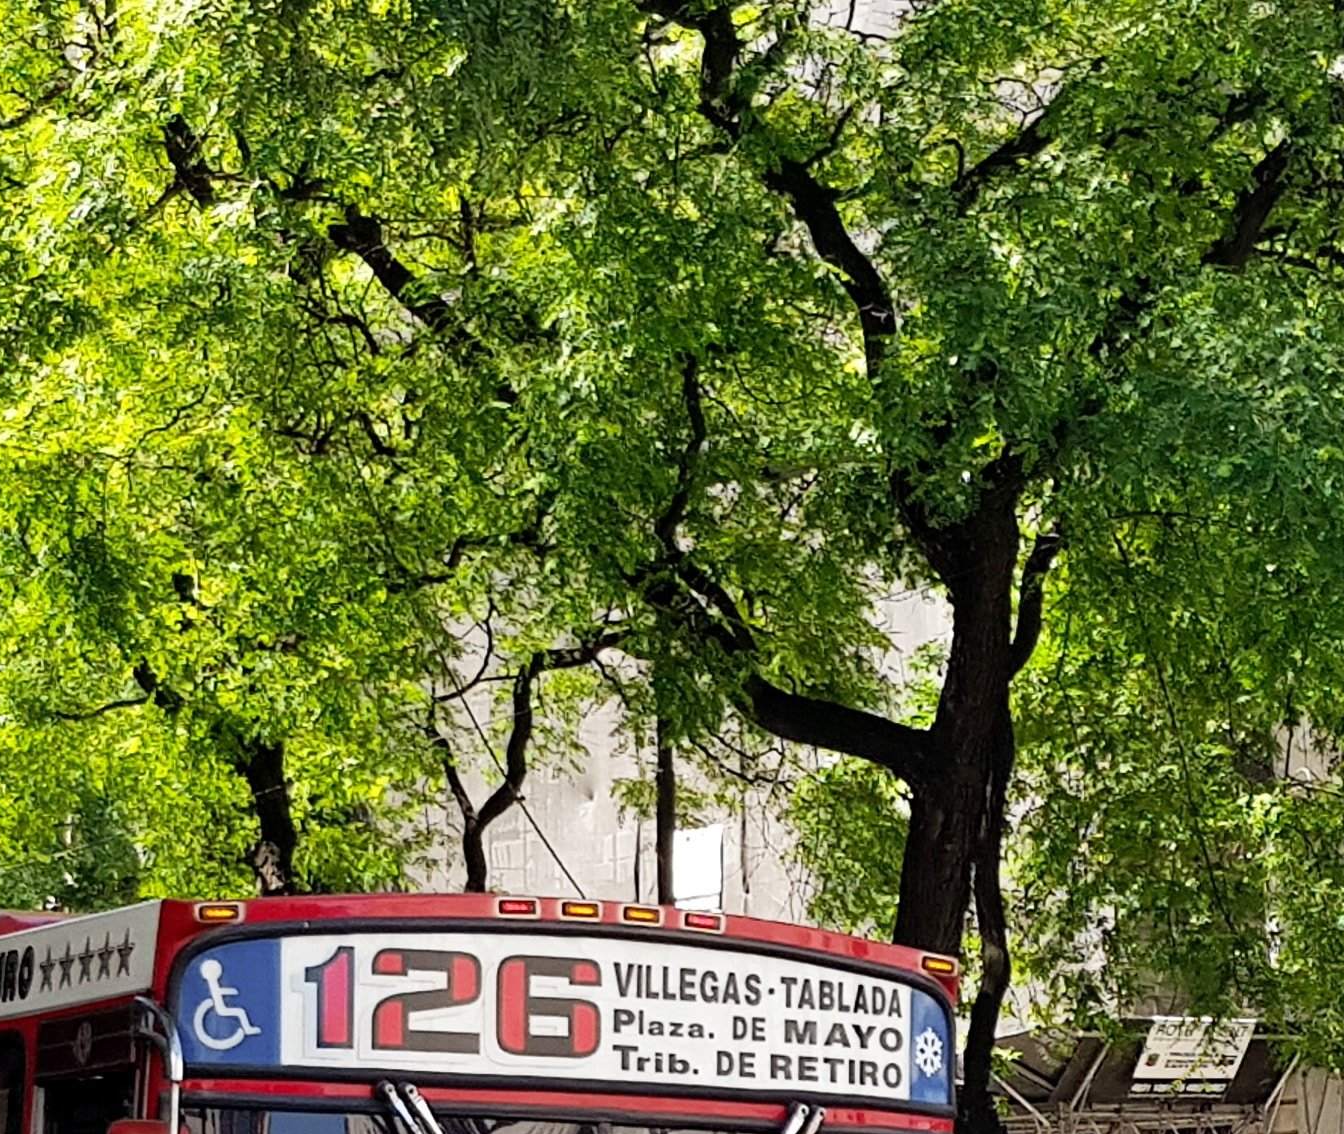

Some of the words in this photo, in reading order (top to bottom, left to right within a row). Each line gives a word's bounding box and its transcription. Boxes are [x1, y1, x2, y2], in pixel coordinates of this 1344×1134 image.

[303, 946, 602, 1058] 126
[613, 1009, 715, 1040] Plaza.
[732, 1016, 766, 1042] DE
[784, 1019, 903, 1053] MAYO
[612, 1045, 699, 1075] Trib.
[716, 1050, 756, 1078] DE
[770, 1053, 902, 1089] RETIRO
